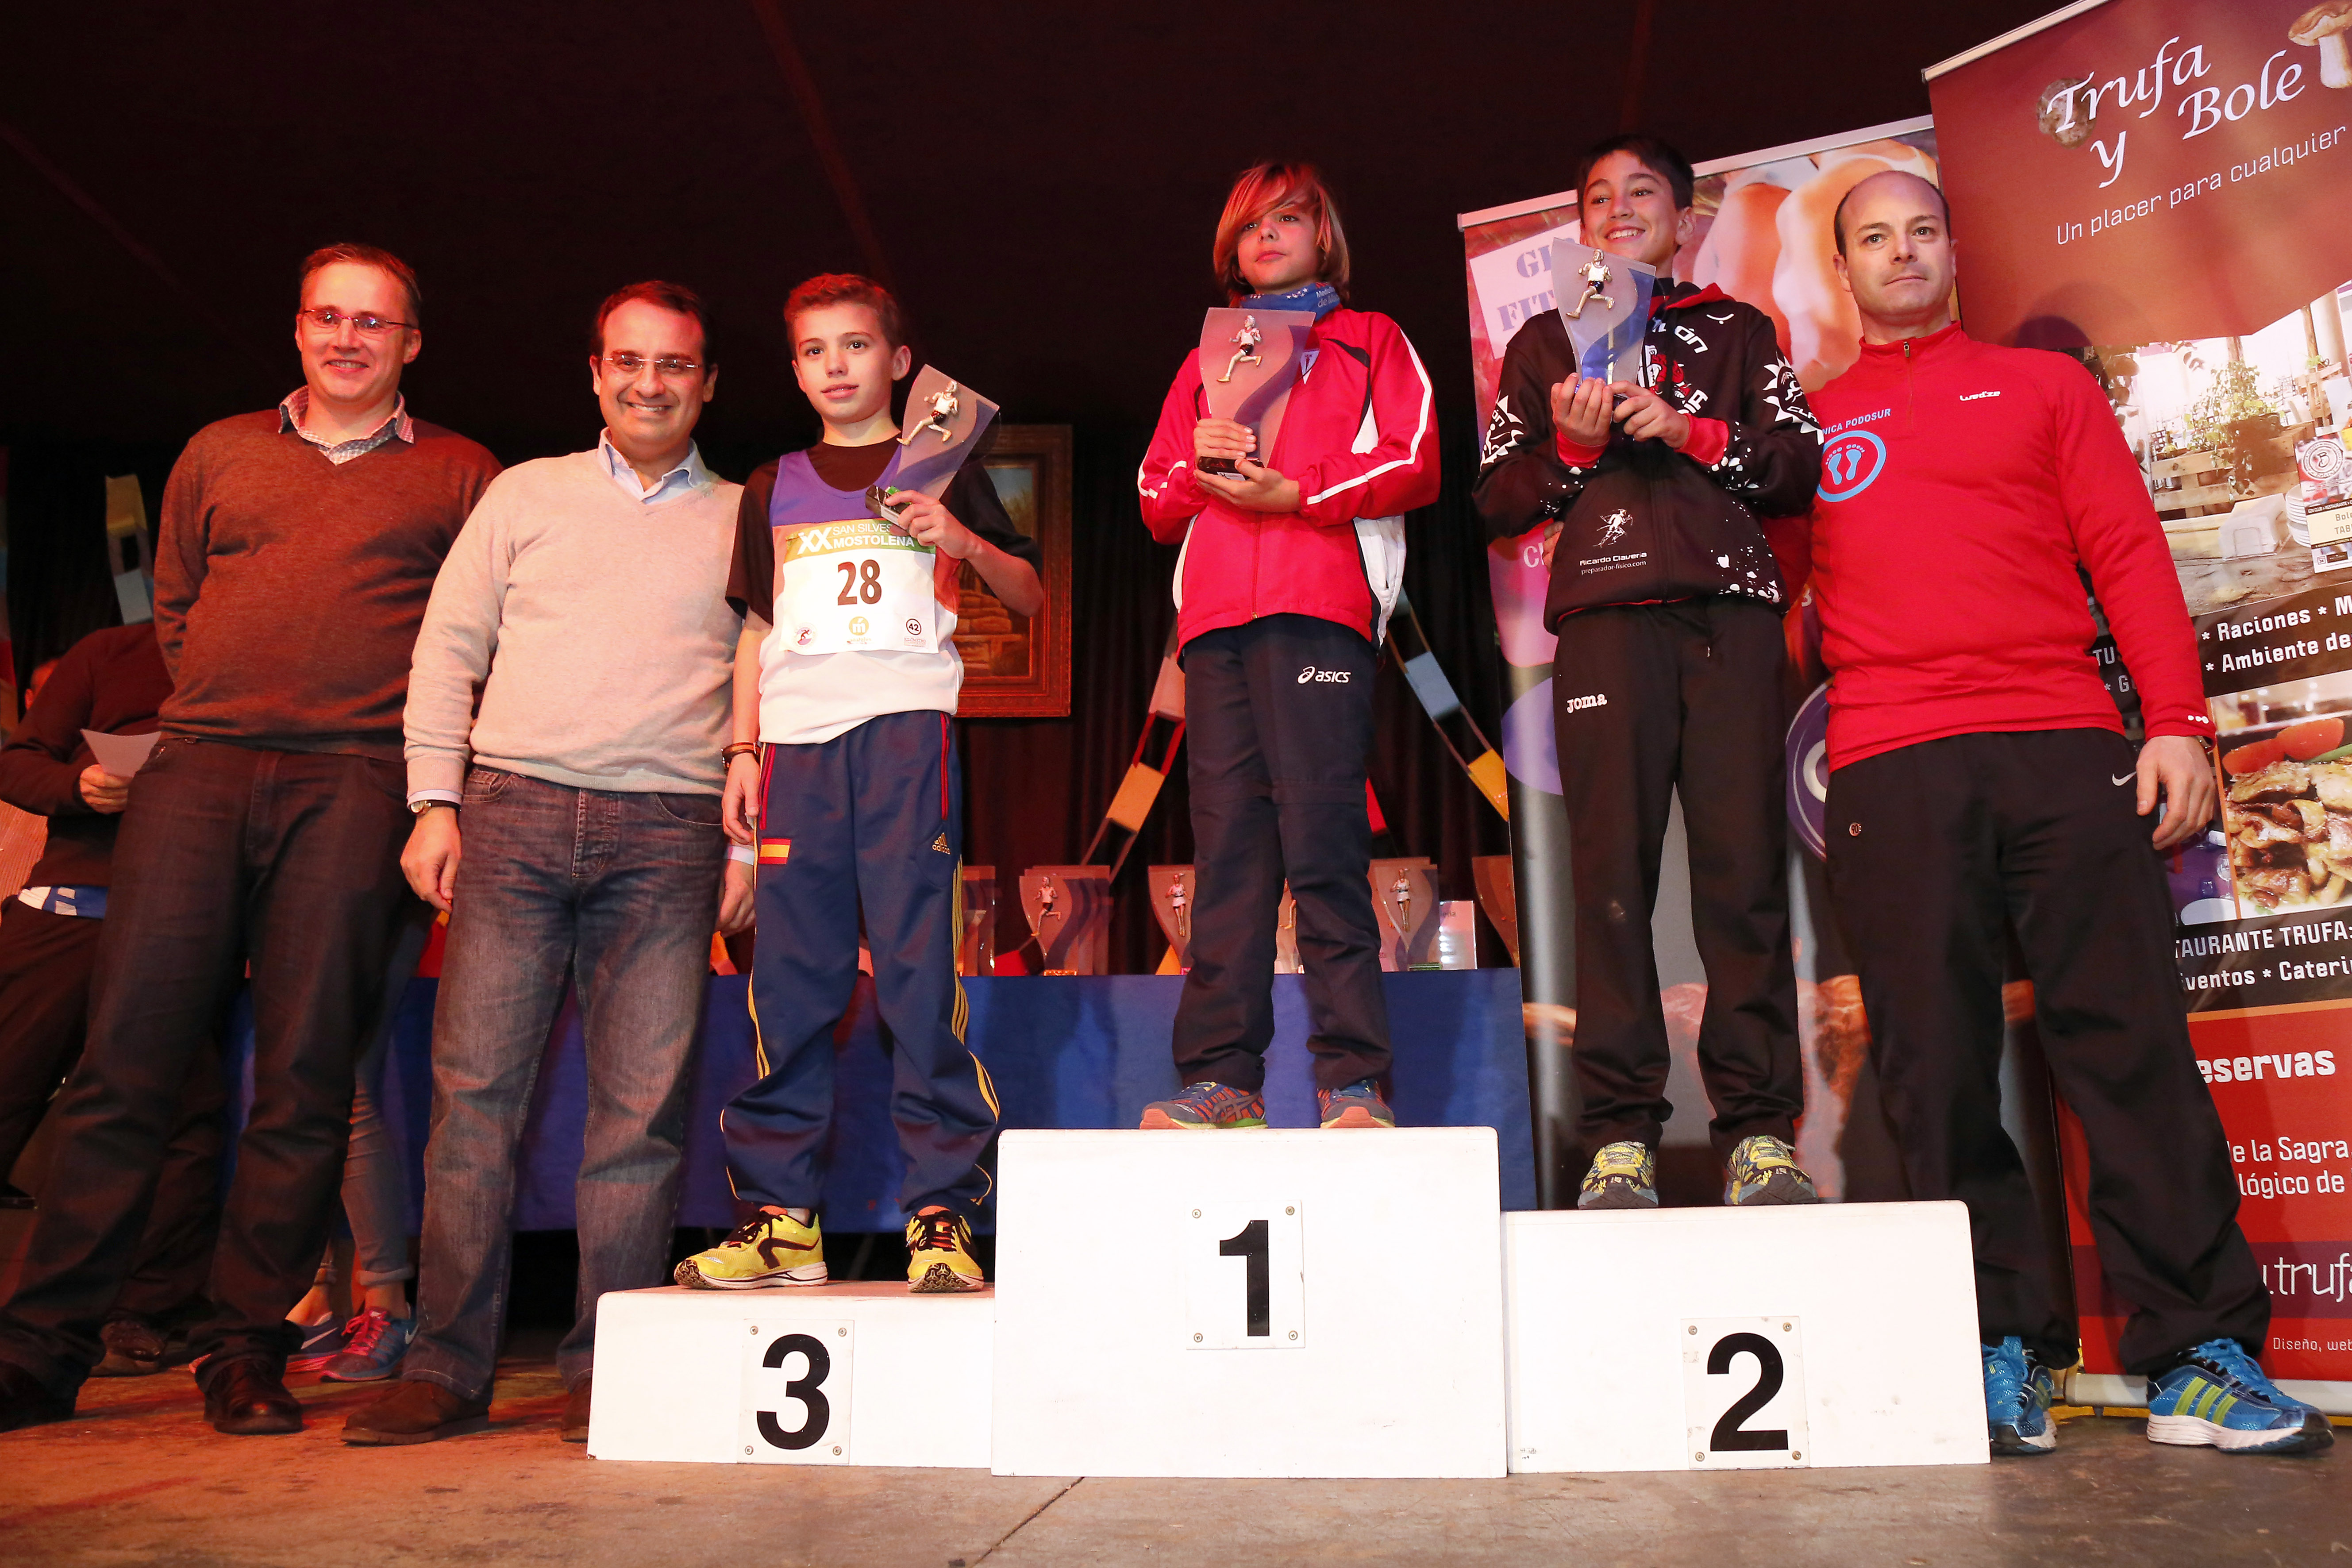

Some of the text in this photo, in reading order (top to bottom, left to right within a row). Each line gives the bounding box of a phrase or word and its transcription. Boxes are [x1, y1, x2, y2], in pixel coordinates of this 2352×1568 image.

[2046, 36, 2211, 133] Trufa
[2090, 50, 2305, 188] y Bole
[2057, 126, 2346, 245] Un placer para cualquier
[1845, 408, 1891, 429] PODOSUR
[797, 527, 834, 555] XX
[832, 524, 855, 536] SAN
[1579, 557, 1611, 566] Ricardo
[837, 559, 882, 606] 28
[908, 623, 919, 632] 42
[2216, 609, 2311, 641] Raciones
[2221, 640, 2319, 673] Ambiente
[2279, 920, 2352, 947] TRUFA:
[2180, 956, 2352, 990] ventos Cateri
[2226, 1140, 2246, 1163] e
[2250, 1139, 2272, 1162] la
[2238, 1170, 2345, 1199] lógico de
[1219, 1220, 1270, 1336] 1
[2262, 1252, 2352, 1303] .truf
[2273, 1337, 2322, 1352] Diseño,
[756, 1333, 831, 1450] 3
[1706, 1332, 1789, 1452] 2
